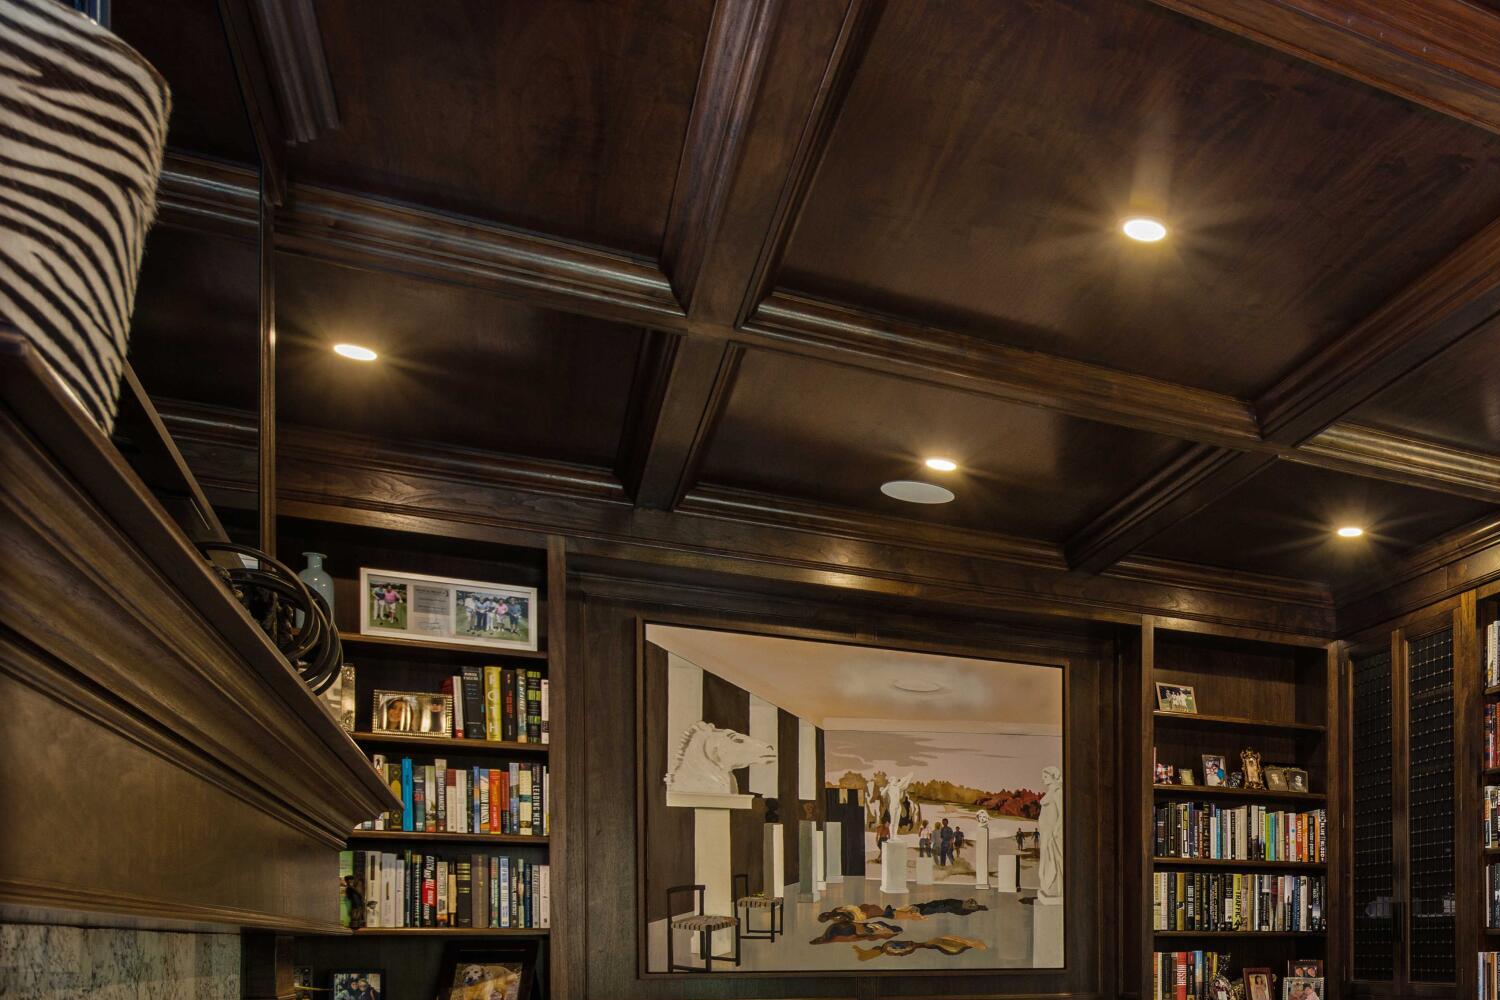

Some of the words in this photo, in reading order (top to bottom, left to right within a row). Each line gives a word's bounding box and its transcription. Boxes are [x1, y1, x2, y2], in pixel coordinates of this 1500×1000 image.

[533, 785, 541, 811] LEADING
[533, 812, 541, 826] MEN
[426, 855, 435, 871] CATCH
[425, 879, 435, 890] KILL
